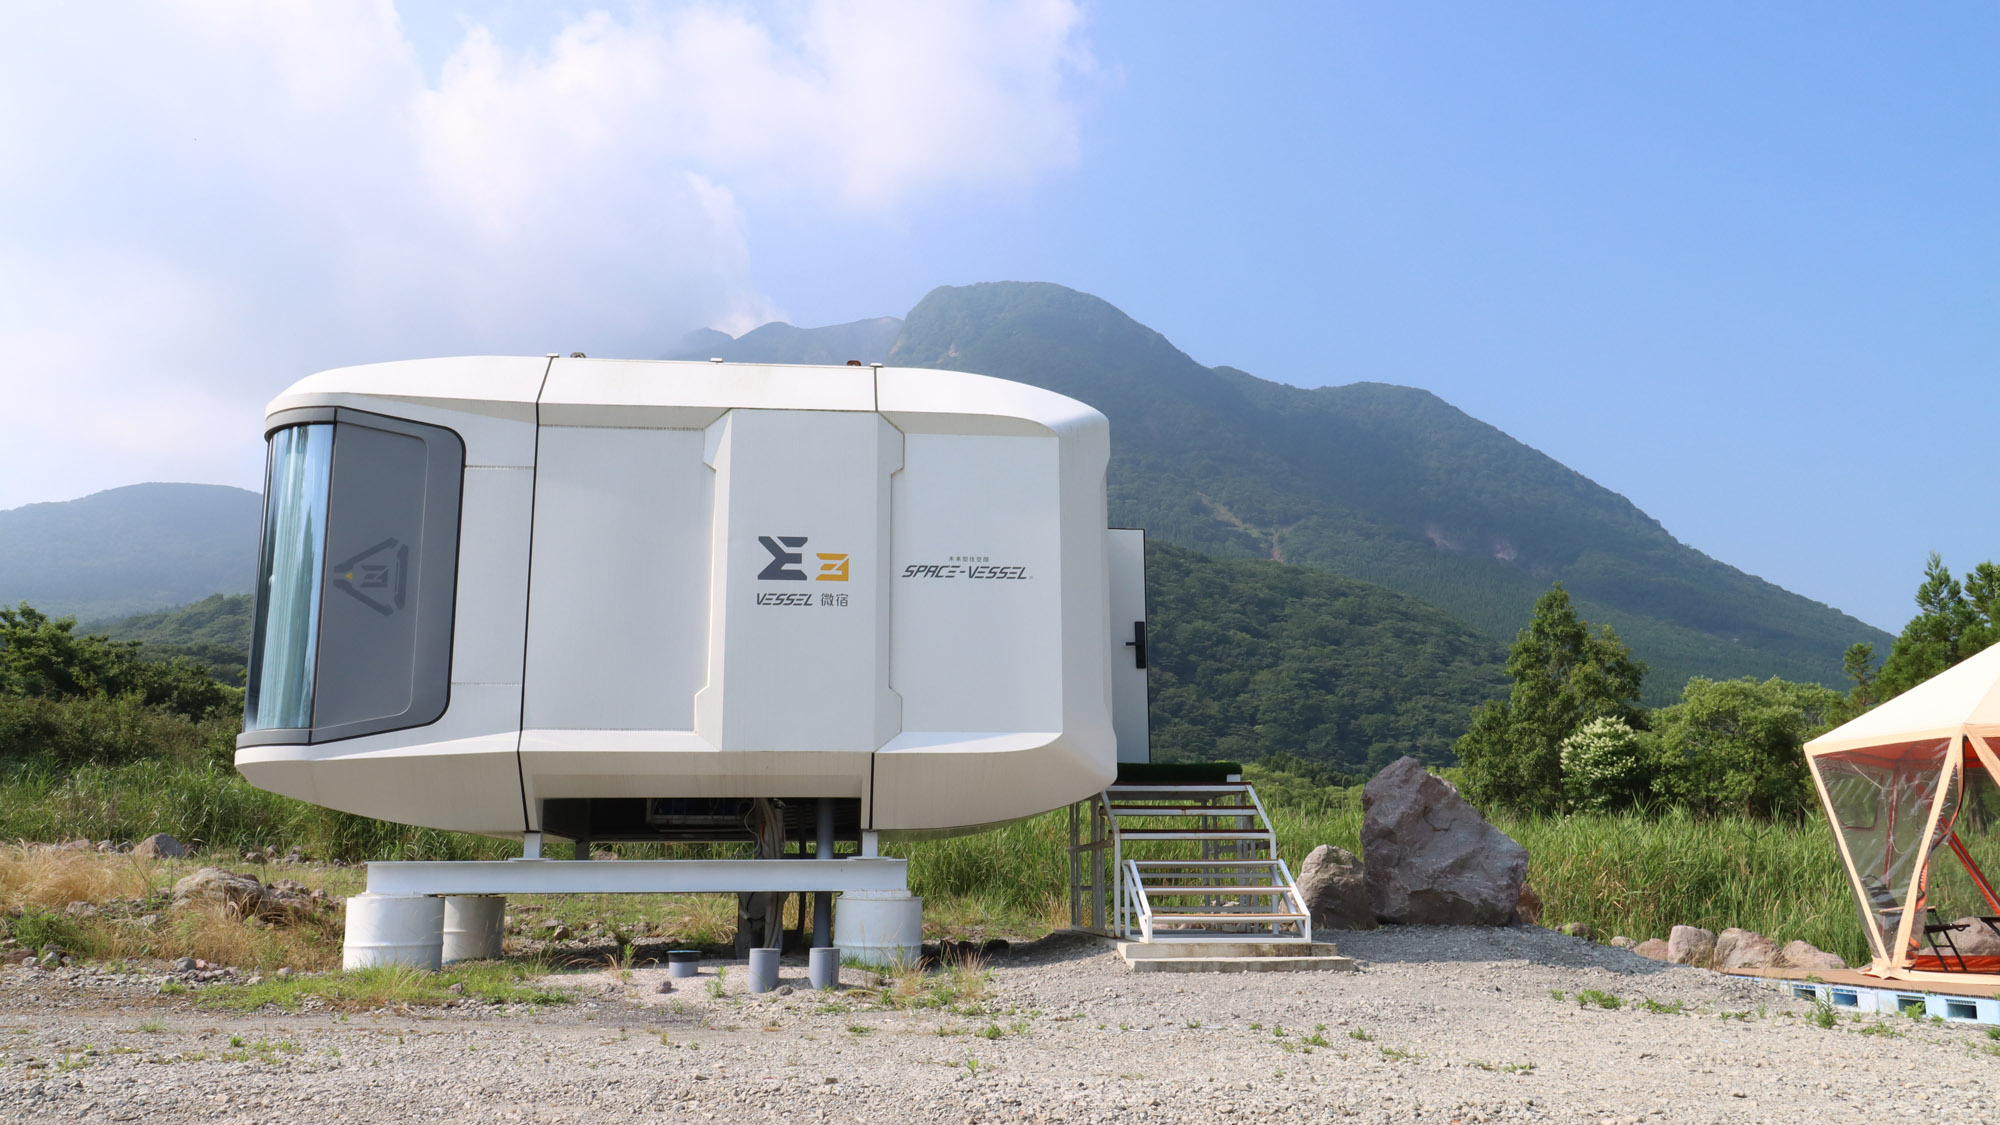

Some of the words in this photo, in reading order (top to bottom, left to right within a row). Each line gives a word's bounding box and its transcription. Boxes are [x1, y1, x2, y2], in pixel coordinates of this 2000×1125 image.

[901, 564, 1027, 580] SPACE-VESSEL
[757, 593, 813, 606] VESSEL
[821, 593, 849, 607] 微宿
